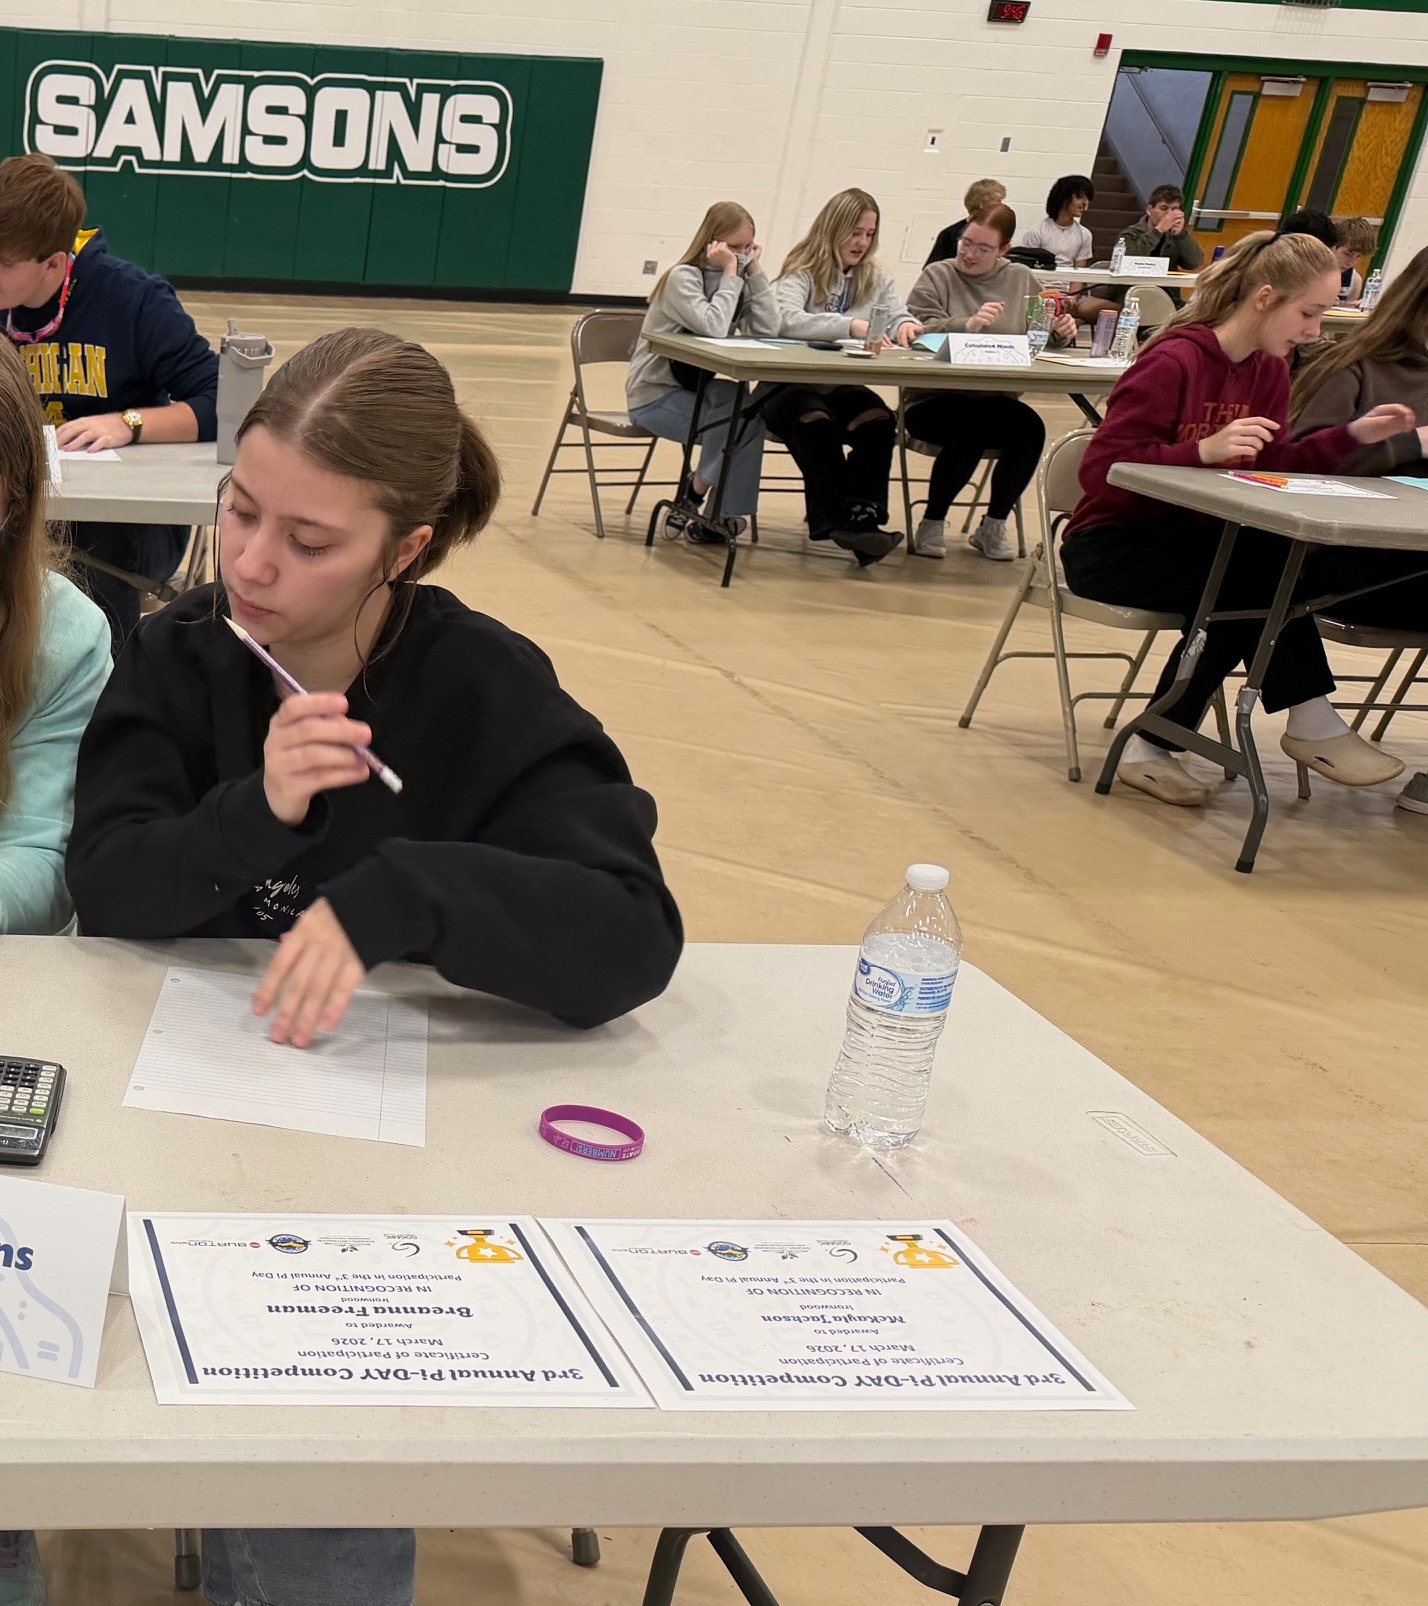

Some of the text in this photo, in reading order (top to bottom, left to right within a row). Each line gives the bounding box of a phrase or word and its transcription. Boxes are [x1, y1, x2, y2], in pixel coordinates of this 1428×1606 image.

[32, 70, 504, 178] SAMSONS
[866, 978, 894, 994] Drinking
[872, 988, 892, 1000] Water
[576, 1144, 617, 1158] NUMBERS!
[252, 1271, 274, 1280] Day
[276, 1272, 288, 1280] Pi
[291, 1272, 332, 1280] Annual
[700, 1274, 724, 1283] Day
[726, 1275, 738, 1283] Pi
[740, 1276, 780, 1284] Annual
[834, 1276, 906, 1284] Participation
[315, 1284, 412, 1292] RECOGNITION
[266, 1304, 474, 1318] Breanna Freeman
[760, 1314, 906, 1324] McKayla Jackson
[331, 1338, 367, 1346] 2026
[398, 1337, 444, 1346] March
[806, 1344, 842, 1352] 2026
[868, 1343, 916, 1352] March
[298, 1350, 490, 1360] Certificate of Participation
[778, 1357, 964, 1366] Certificate of Participation
[202, 1365, 584, 1382] 3rd Annual Pi-DAY Competition
[698, 1372, 1066, 1388] 3rd Annual Pi-DAY Competition
